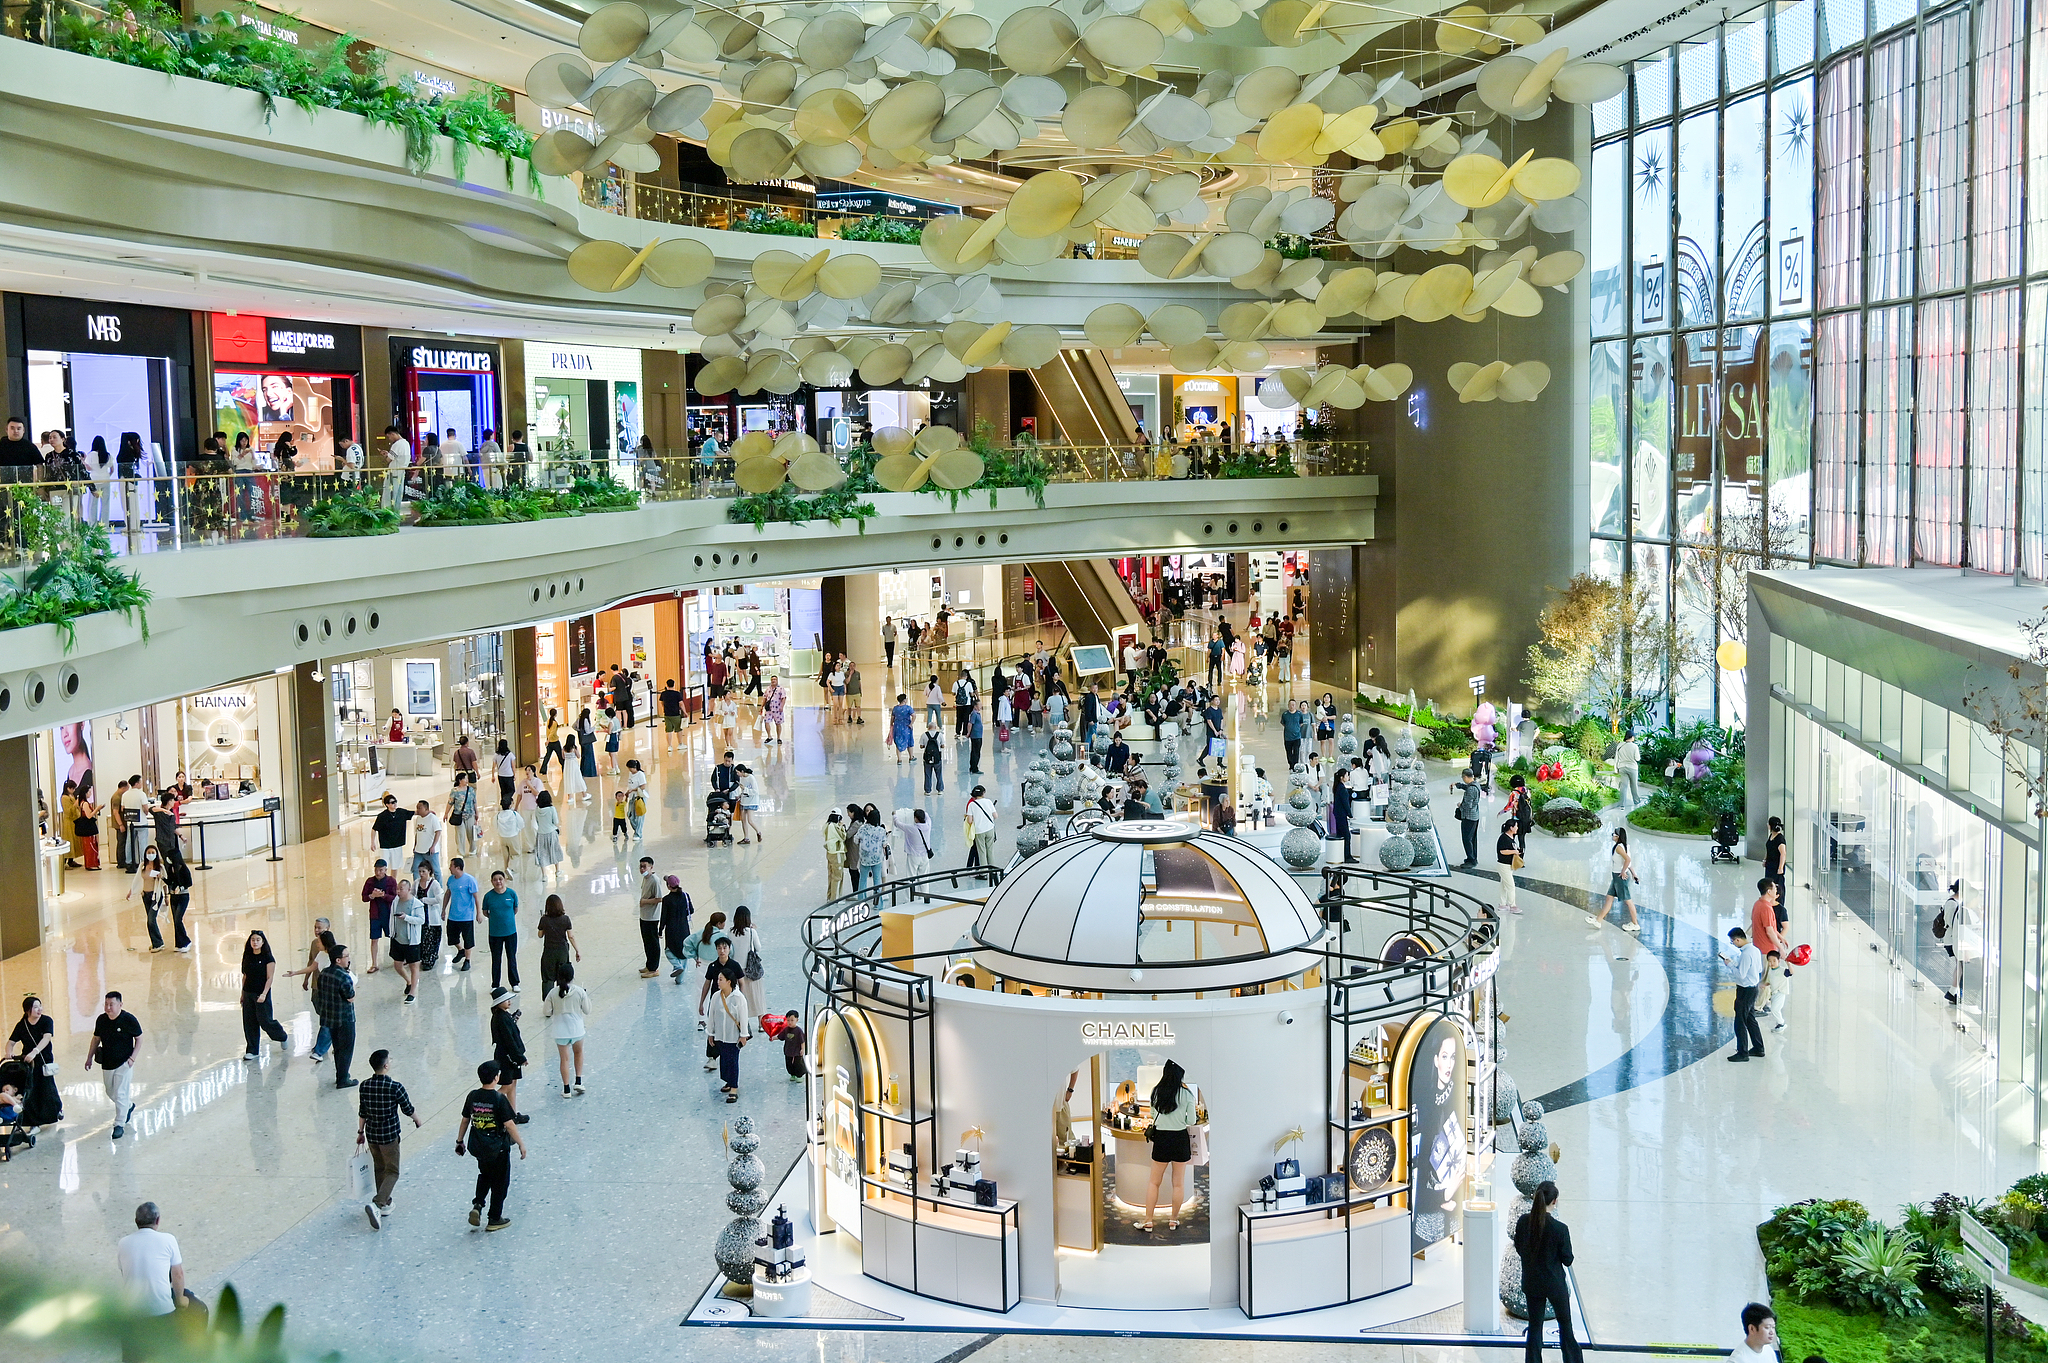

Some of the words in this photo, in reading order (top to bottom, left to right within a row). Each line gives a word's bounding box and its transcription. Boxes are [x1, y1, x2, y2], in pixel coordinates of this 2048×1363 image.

[87, 314, 121, 342] NARS
[413, 346, 439, 368] shu
[440, 351, 491, 371] uemura
[552, 352, 593, 370] PRADA
[195, 696, 246, 708] HAINAN
[1156, 904, 1223, 915] CONSTELLATION
[1082, 1023, 1175, 1038] CHANEL
